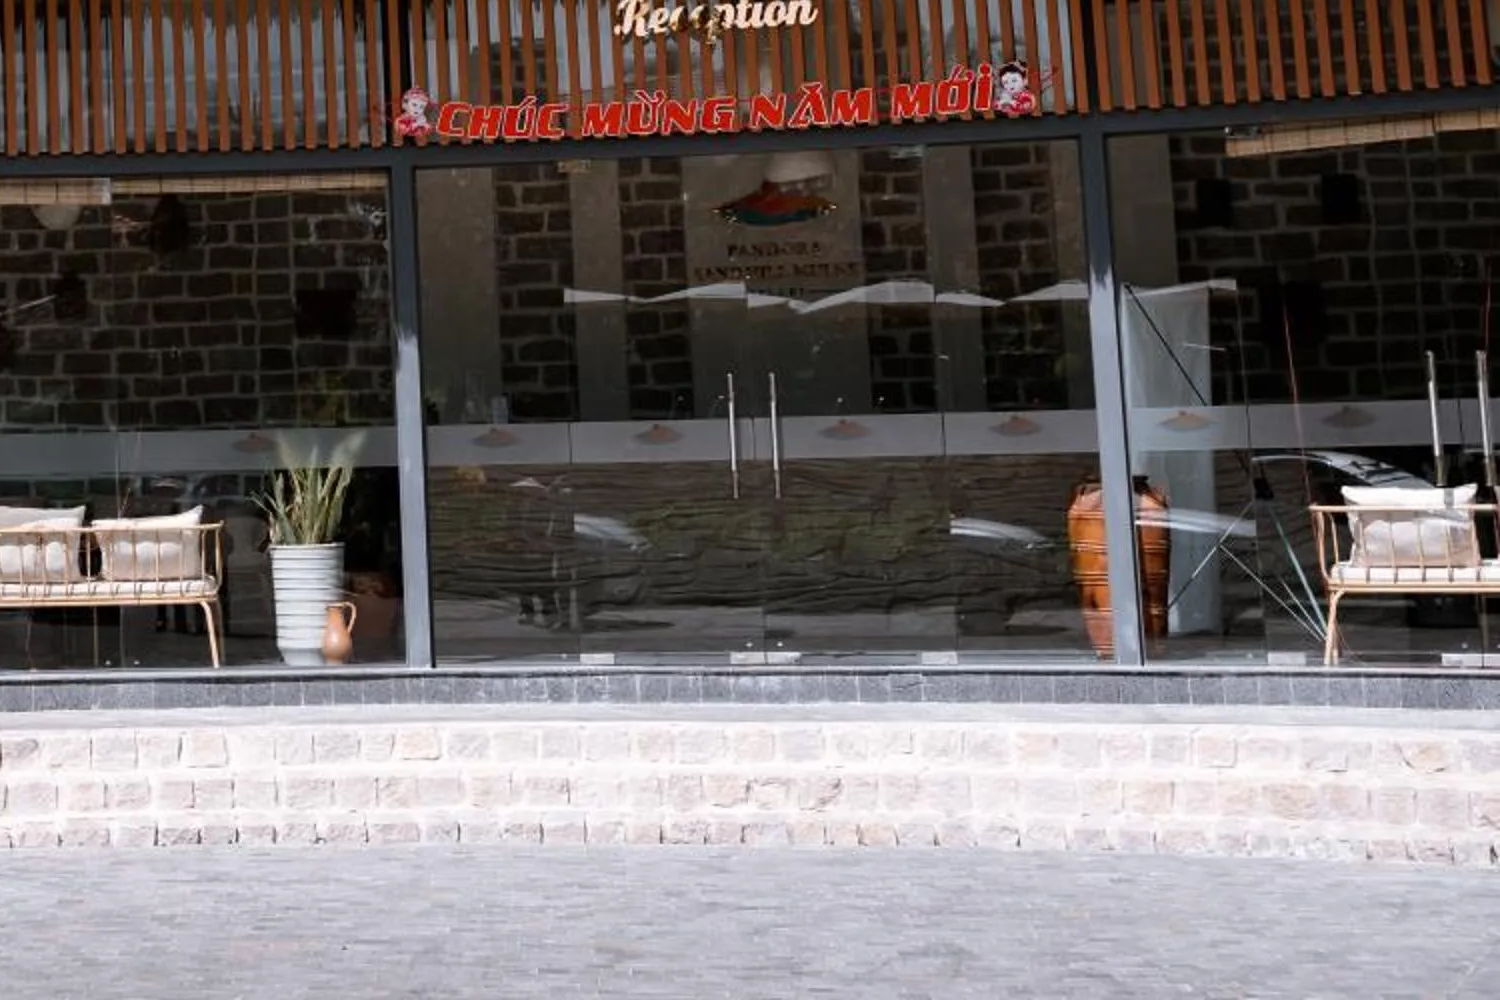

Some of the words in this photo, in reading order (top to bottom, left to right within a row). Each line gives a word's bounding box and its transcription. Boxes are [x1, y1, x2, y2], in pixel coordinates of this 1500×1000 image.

[436, 95, 568, 139] CHÚC
[582, 89, 737, 138] MỪNG
[751, 81, 874, 129] NĂM
